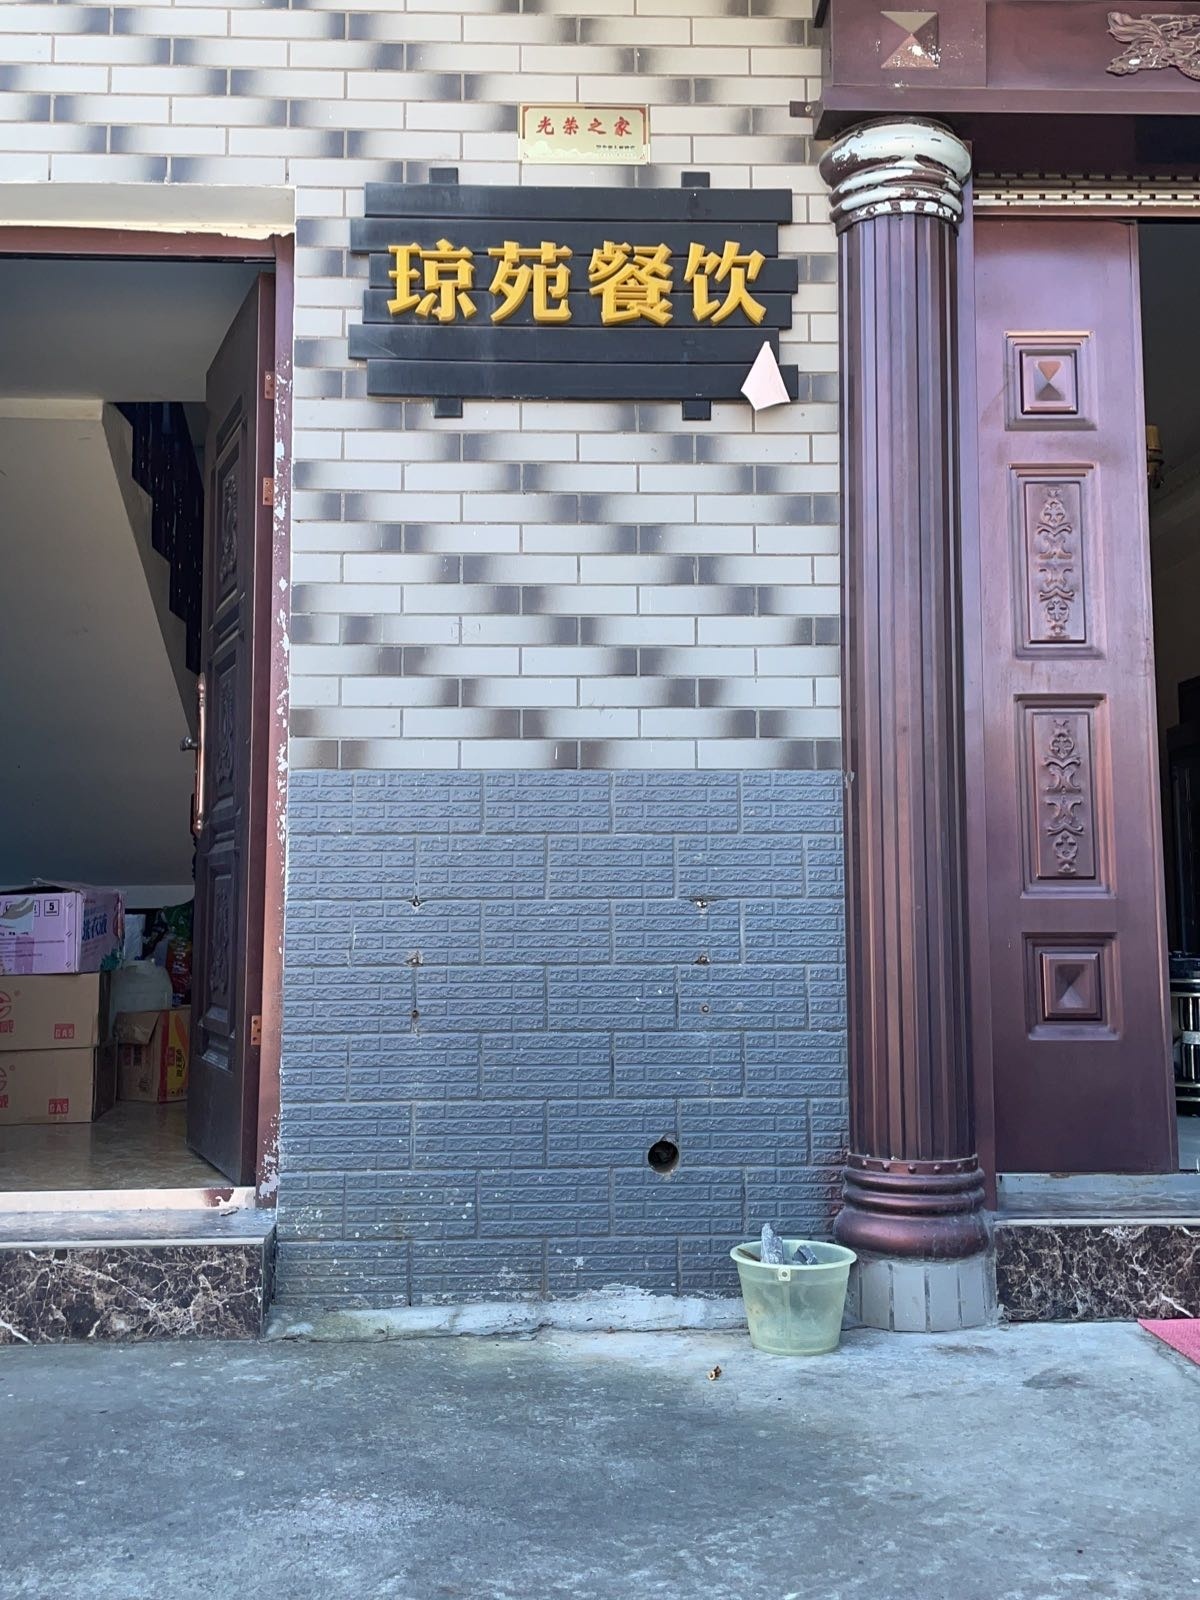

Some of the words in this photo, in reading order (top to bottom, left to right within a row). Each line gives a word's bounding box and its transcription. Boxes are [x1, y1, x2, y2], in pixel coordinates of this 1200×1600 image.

[536, 116, 632, 137] 光荣之家
[387, 238, 767, 326] 琼苑餐饮
